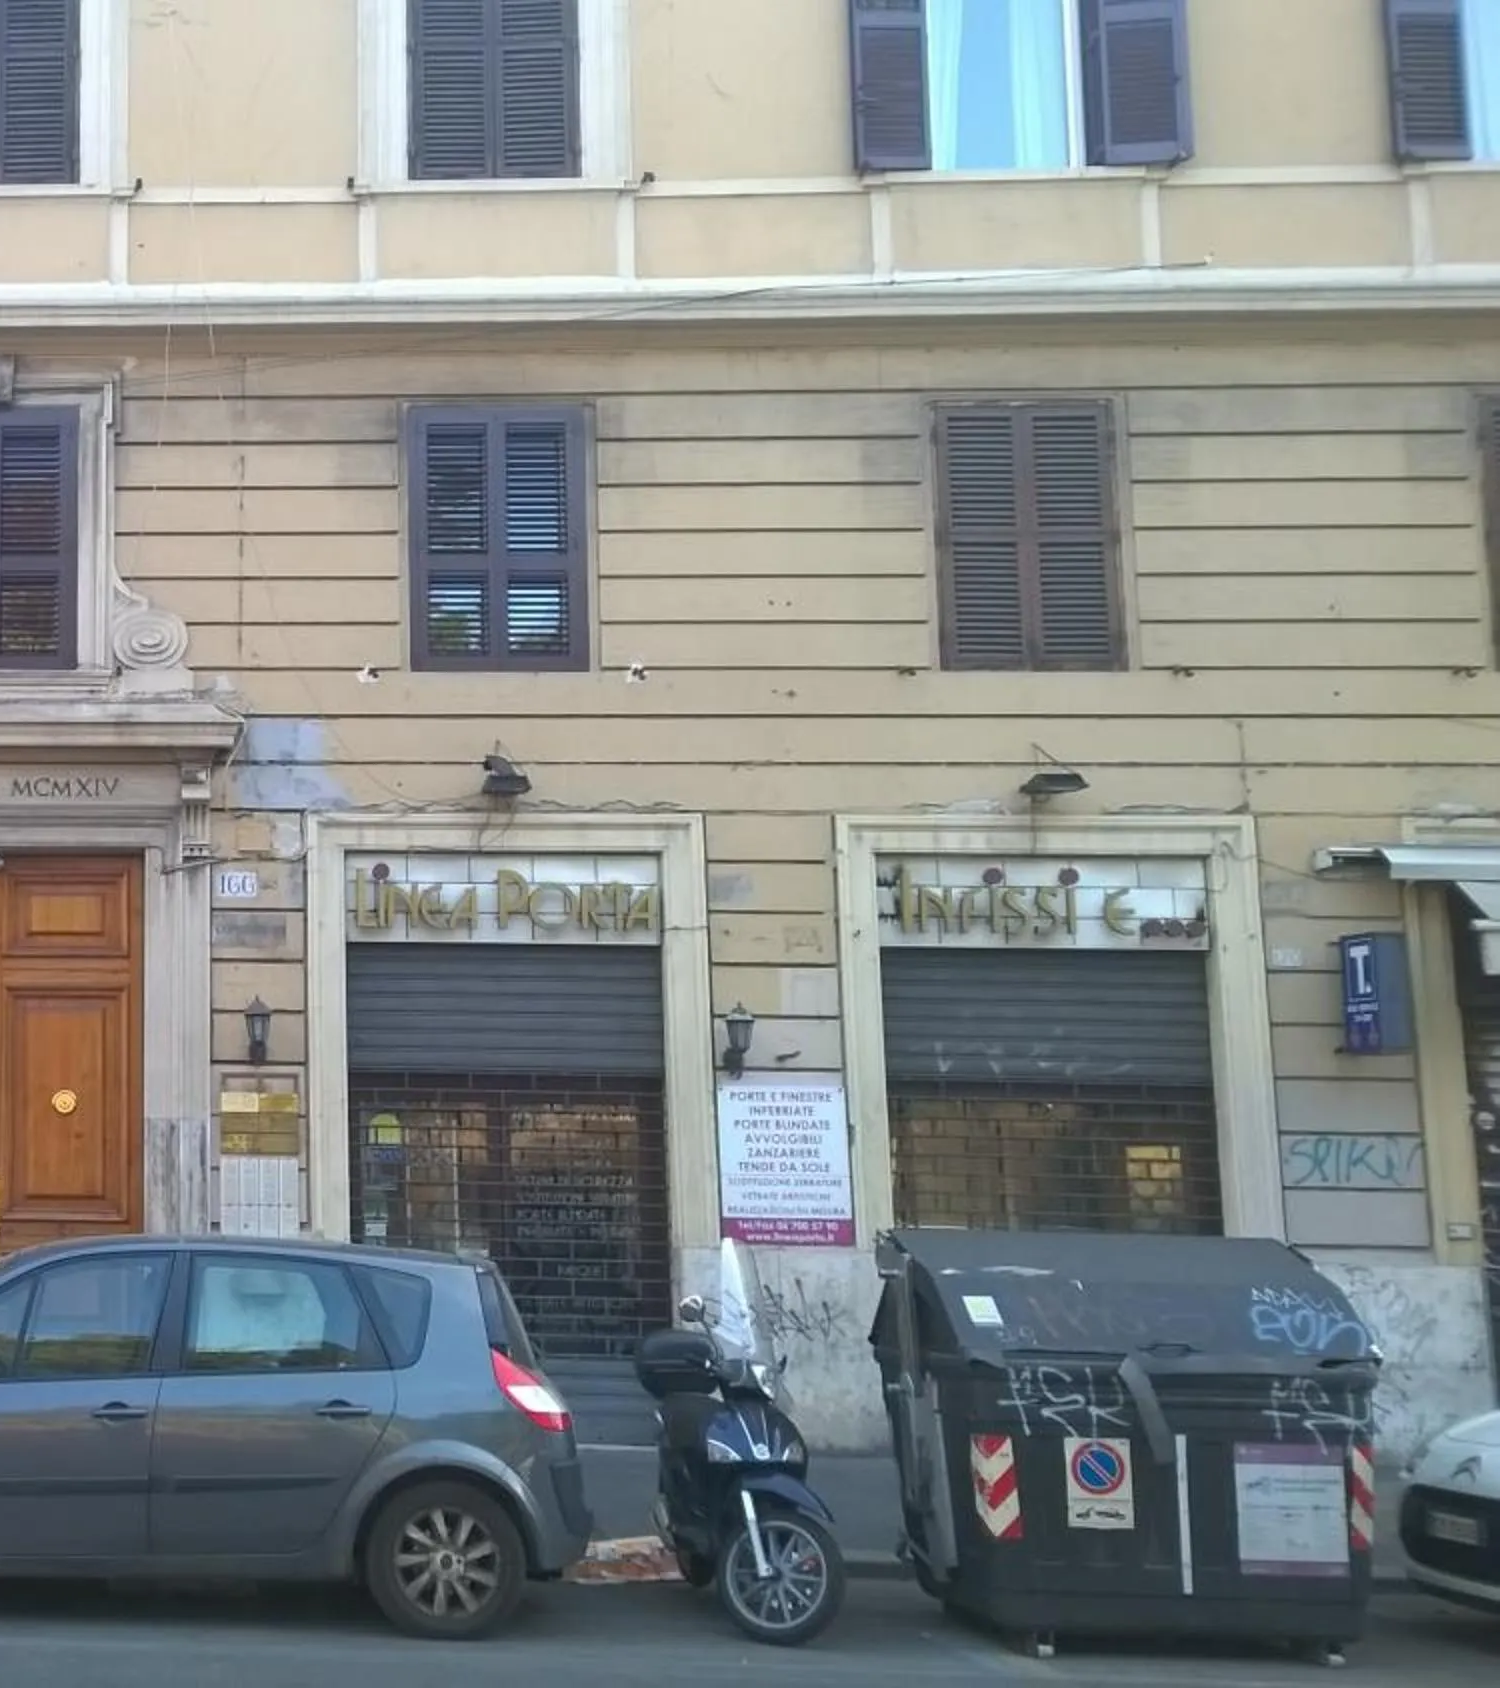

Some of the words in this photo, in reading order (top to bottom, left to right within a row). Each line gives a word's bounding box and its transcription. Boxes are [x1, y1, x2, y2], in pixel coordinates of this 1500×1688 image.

[11, 777, 119, 798] MCMXIV
[220, 873, 255, 894] 166
[496, 867, 658, 932] PORTA
[729, 1091, 766, 1101] PORTE
[781, 1092, 833, 1102] FINESTRE
[749, 1106, 816, 1116] INFERRIATE
[734, 1120, 770, 1130] PORTE
[775, 1120, 831, 1130] BLINDATE
[745, 1134, 823, 1144] AVVOLGIBILI
[747, 1148, 821, 1158] ZANZARIERE
[738, 1161, 775, 1172] TENDE
[779, 1161, 797, 1172] DA
[801, 1162, 831, 1173] SOLE
